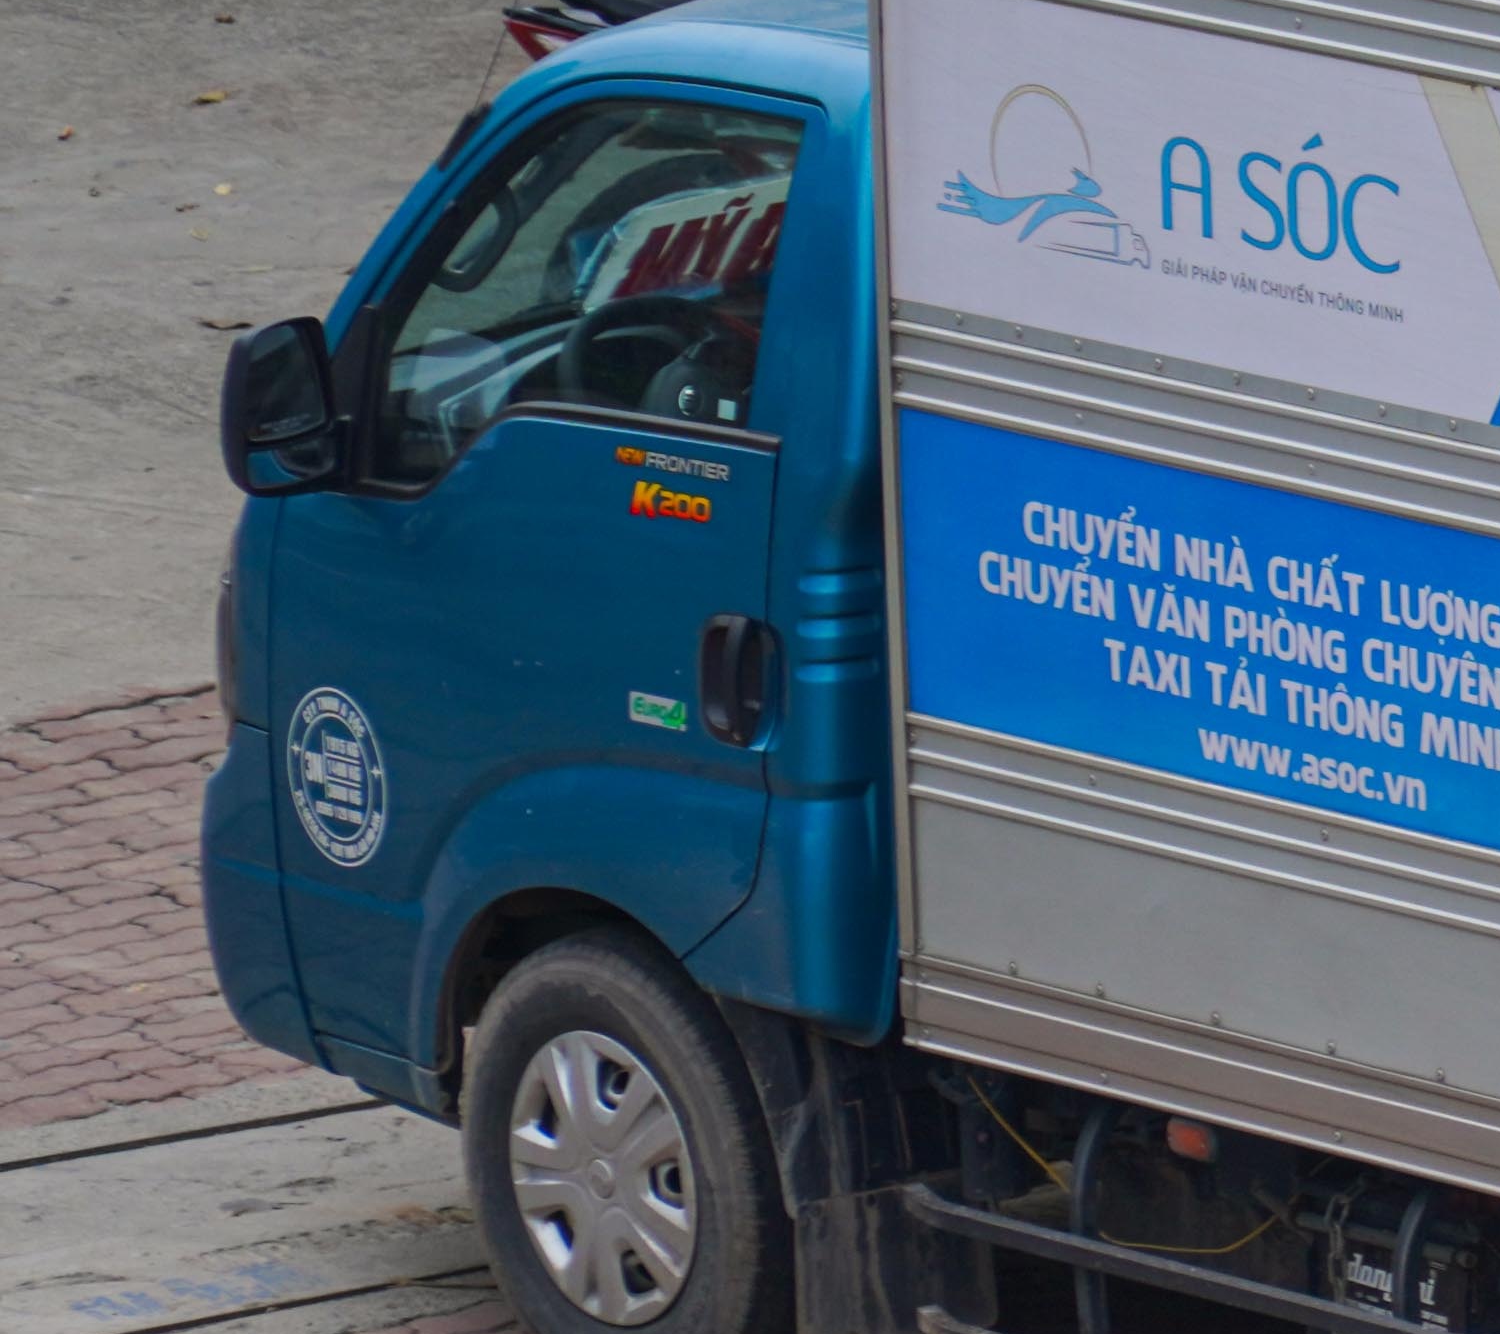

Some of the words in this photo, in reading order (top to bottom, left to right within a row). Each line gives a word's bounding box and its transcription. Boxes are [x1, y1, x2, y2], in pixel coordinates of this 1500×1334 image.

[1160, 135, 1215, 240] A
[1238, 132, 1401, 275] SÓC
[1160, 257, 1188, 279] GIẢI
[1191, 265, 1227, 286] PHÁP
[1230, 273, 1258, 296] VẬN
[1317, 290, 1365, 316] THÔNG
[1367, 302, 1405, 324] MINH
[629, 480, 713, 524] K200
[644, 451, 731, 482] FRONTIER
[1022, 500, 1162, 574] CHUYỂN
[1172, 532, 1255, 597] NHÀ
[1266, 552, 1367, 619] CHẤT
[978, 549, 1116, 623] CHUYỂN
[1128, 581, 1211, 646] VĂN
[1223, 601, 1348, 677] PHÒNG
[1103, 637, 1192, 701] TAXI
[1203, 656, 1268, 719] TẢI
[1280, 679, 1406, 750] THÔNG
[1198, 727, 1429, 812] www.asoc.vn
